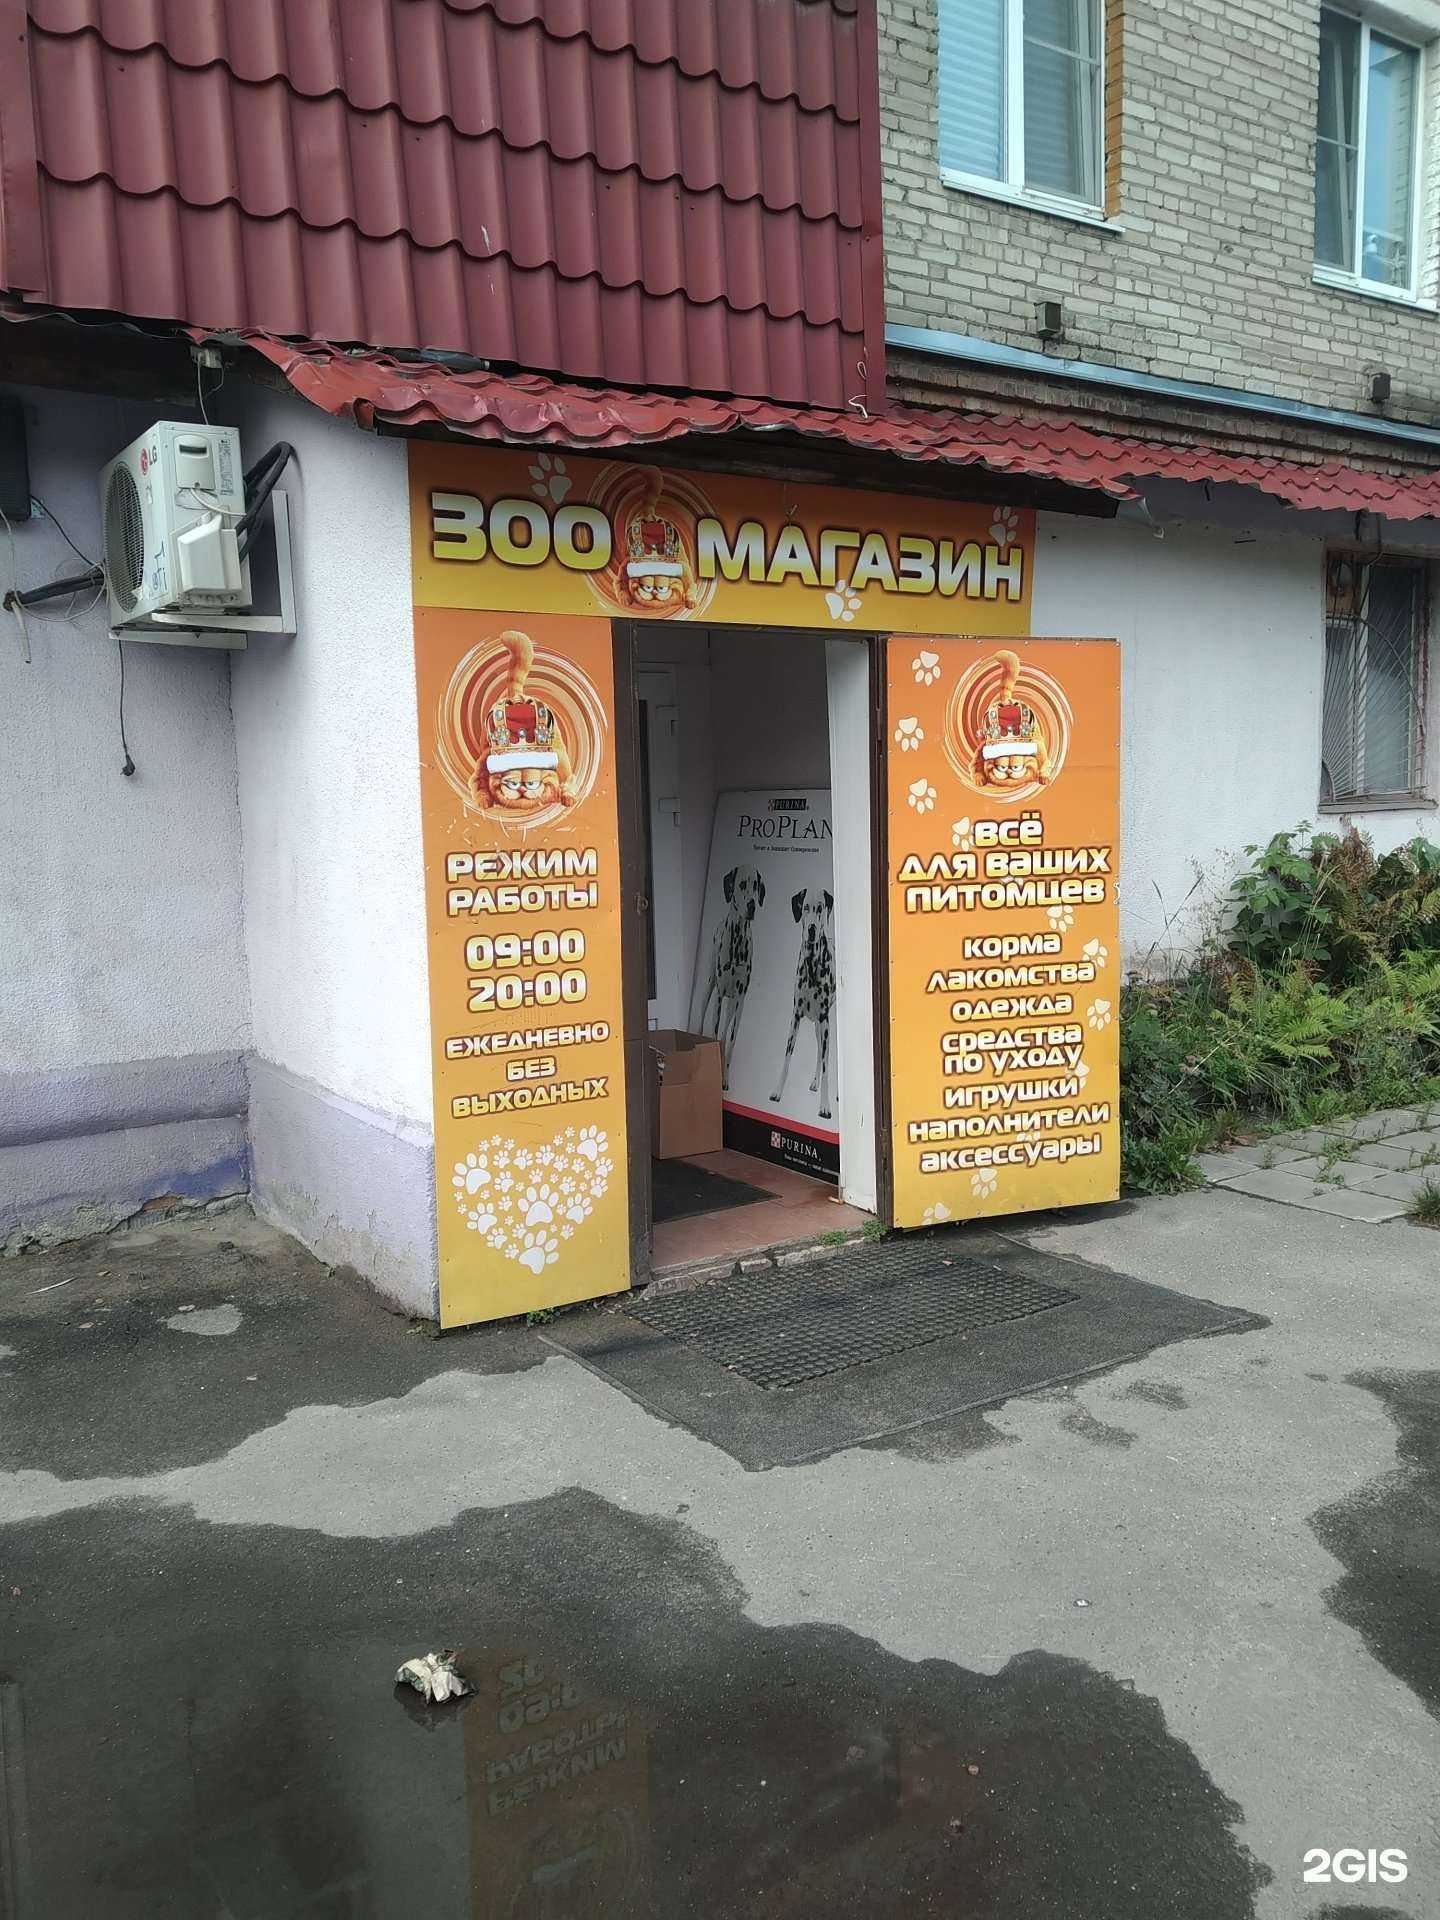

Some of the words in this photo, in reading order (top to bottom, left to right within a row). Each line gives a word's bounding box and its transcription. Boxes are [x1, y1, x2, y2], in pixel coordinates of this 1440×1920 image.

[430, 491, 612, 571] ЗОО
[697, 518, 1023, 601] МАГАЗИН
[973, 812, 1043, 848] всё
[446, 848, 598, 882] РЕЖИМ
[898, 852, 977, 883] для
[985, 847, 1112, 880] ваших
[447, 882, 599, 916] РАБОТЫ
[905, 877, 1106, 913] питомцев
[466, 929, 586, 971] 09:00
[963, 932, 1062, 961] корма
[467, 969, 587, 1013] 20:00
[926, 961, 1096, 994] лакомства
[950, 994, 1073, 1023] одежда
[445, 1021, 610, 1059] ЕЖЕДНЕВНО
[941, 1024, 1083, 1055] средства
[506, 1056, 557, 1081] БЕЗ
[943, 1051, 983, 1076] по
[990, 1044, 1084, 1077] уходу
[452, 1077, 609, 1119] ВЫХОДНЫХ
[943, 1076, 1080, 1110] игрушки
[908, 1102, 1111, 1144] наполнители
[781, 1137, 819, 1160] PURINA
[919, 1134, 1101, 1175] аксессуары
